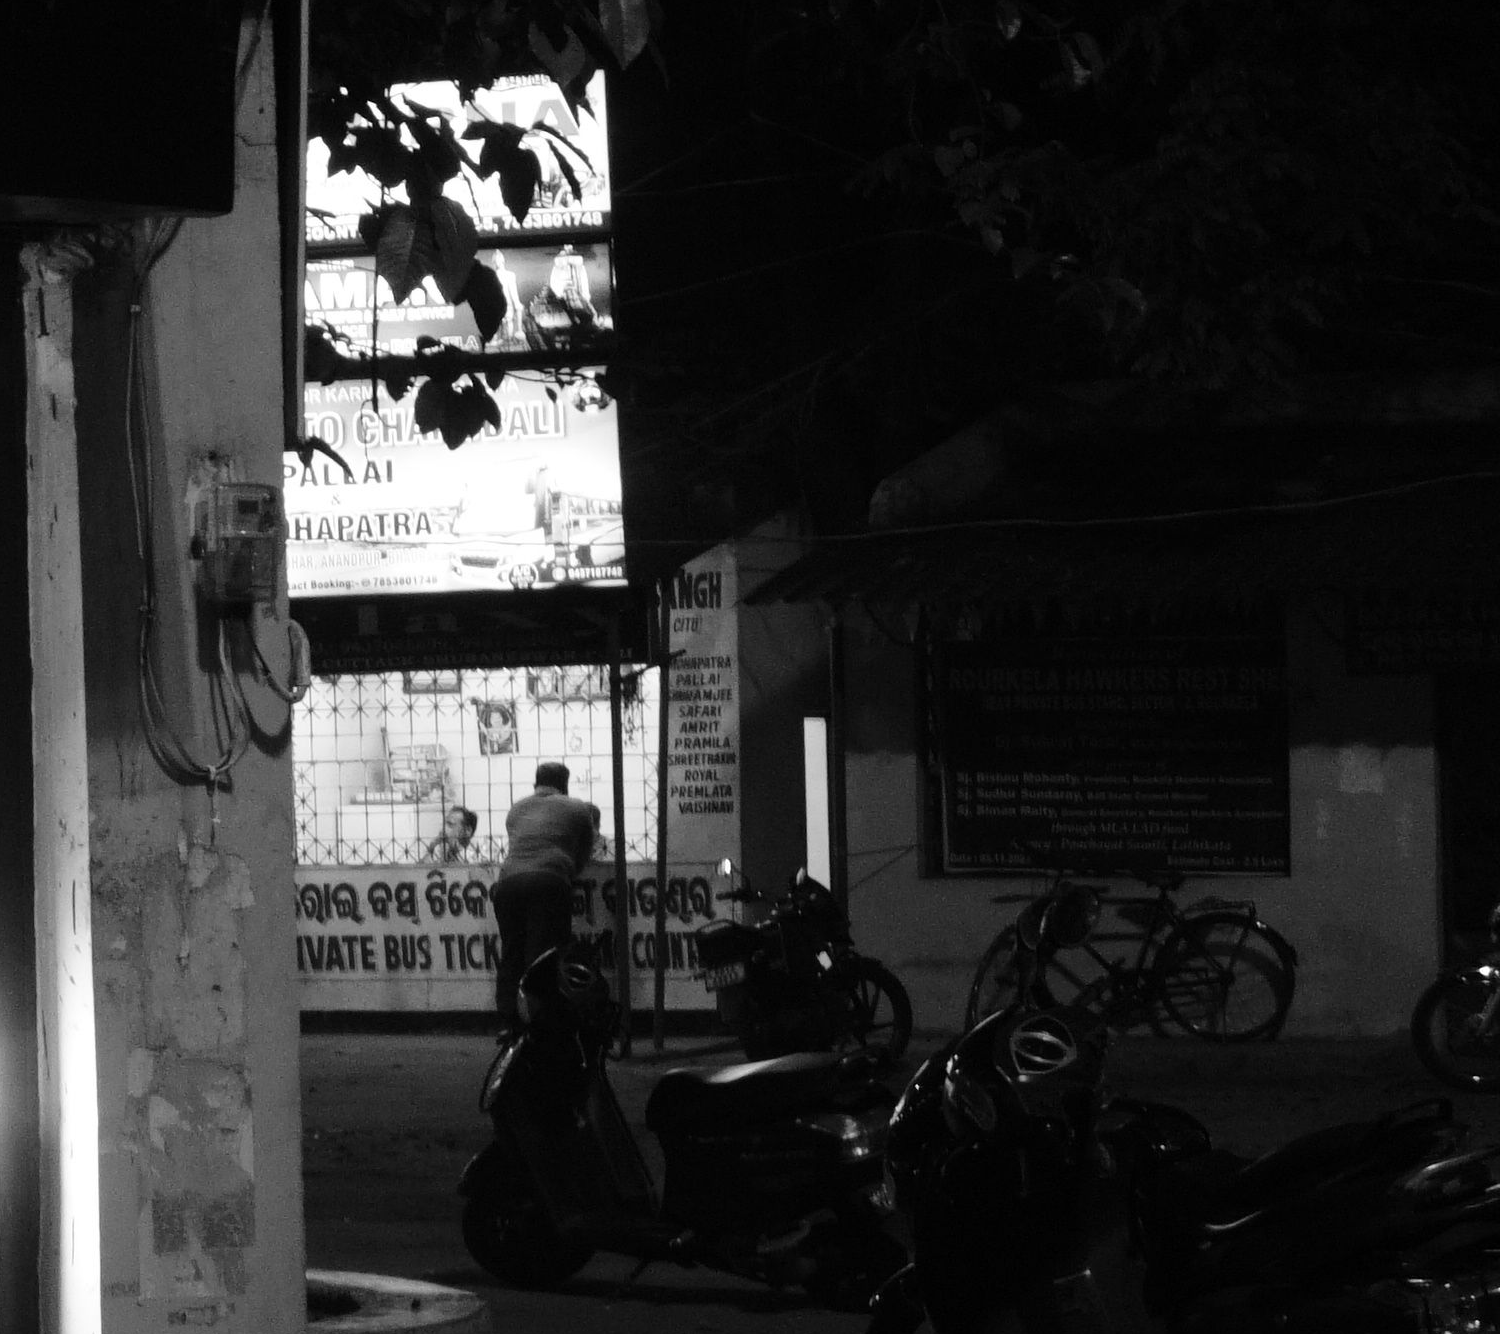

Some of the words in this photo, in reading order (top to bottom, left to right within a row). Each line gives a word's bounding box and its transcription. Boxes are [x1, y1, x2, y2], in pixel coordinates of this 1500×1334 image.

[657, 571, 722, 610] ANGH
[678, 703, 722, 718] SAFARI
[679, 719, 720, 734] AMRIT
[674, 735, 731, 750] PRAMILA
[684, 767, 720, 783] ROYAL
[296, 933, 377, 971] IVATE
[384, 934, 433, 971] BUS
[439, 932, 501, 971] TICK
